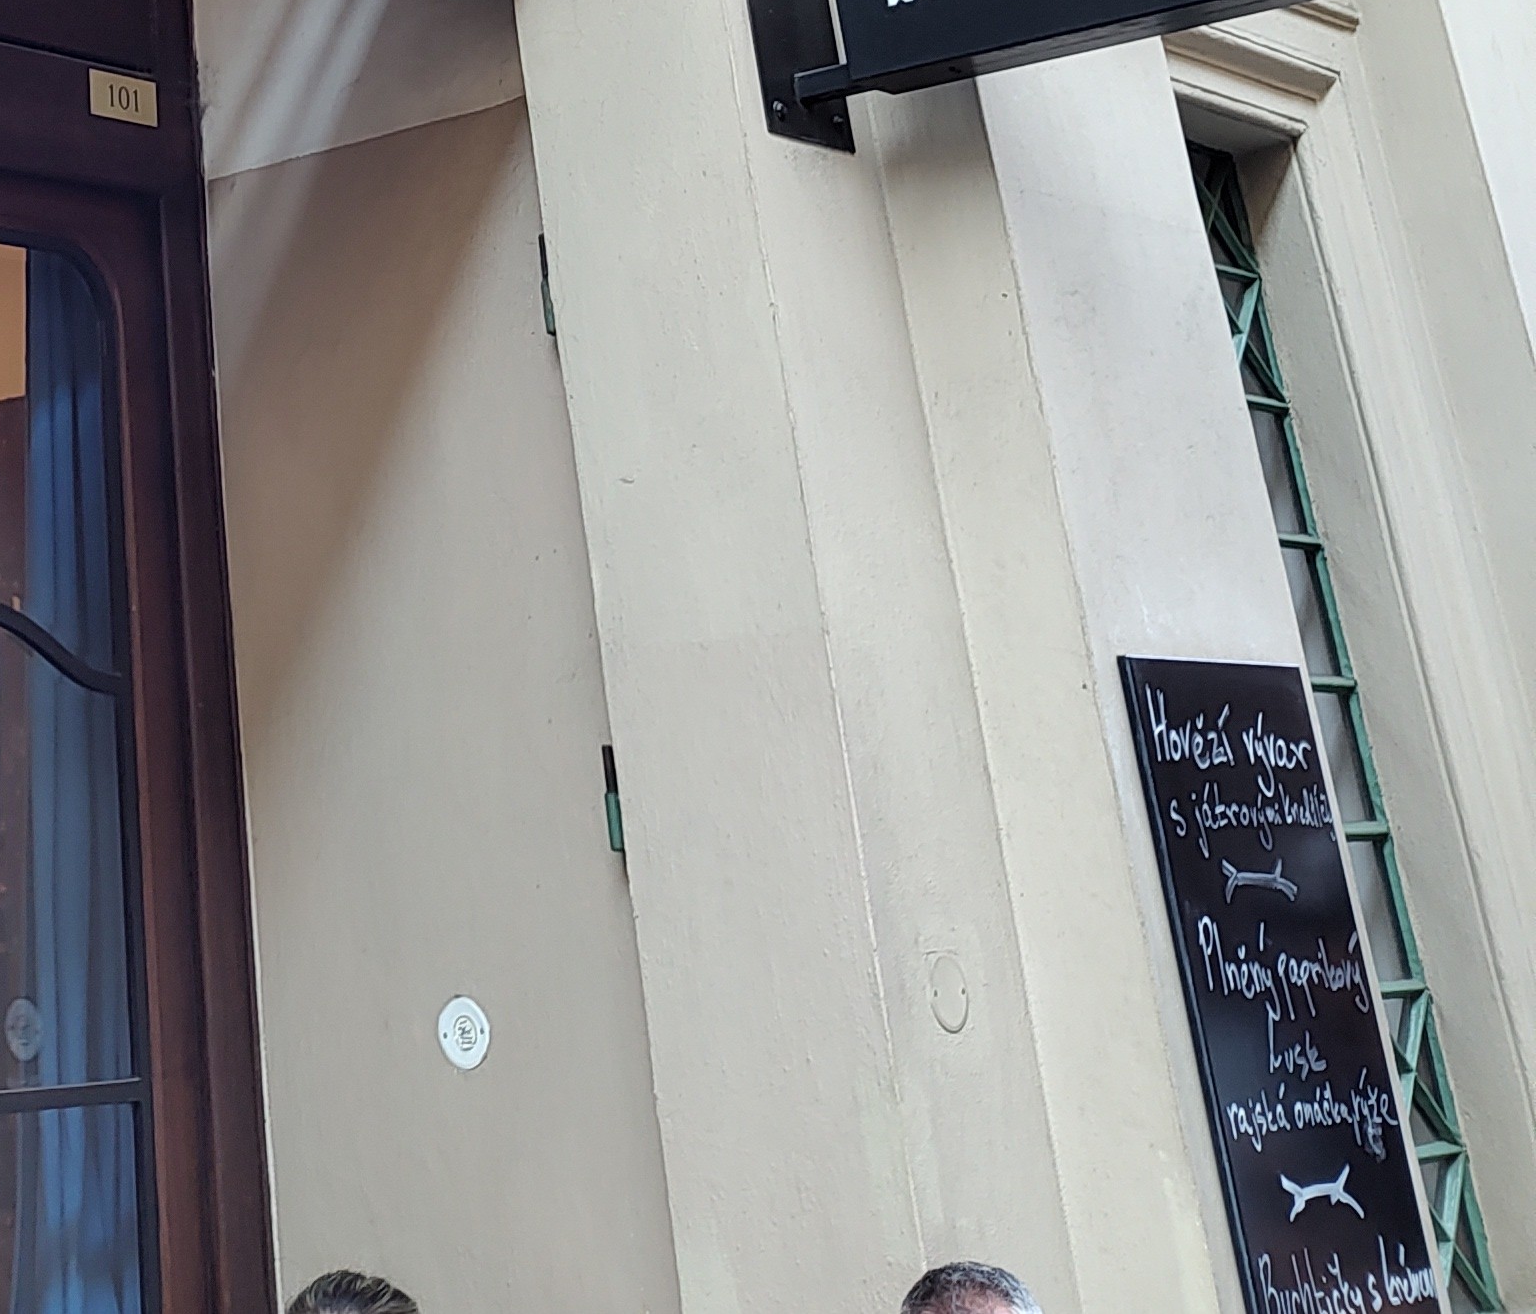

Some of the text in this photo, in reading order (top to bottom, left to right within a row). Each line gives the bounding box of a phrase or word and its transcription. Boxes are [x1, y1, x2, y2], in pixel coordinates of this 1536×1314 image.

[108, 83, 140, 113] 101
[1145, 683, 1312, 798] Hovězí vývar
[1170, 799, 1186, 837] s
